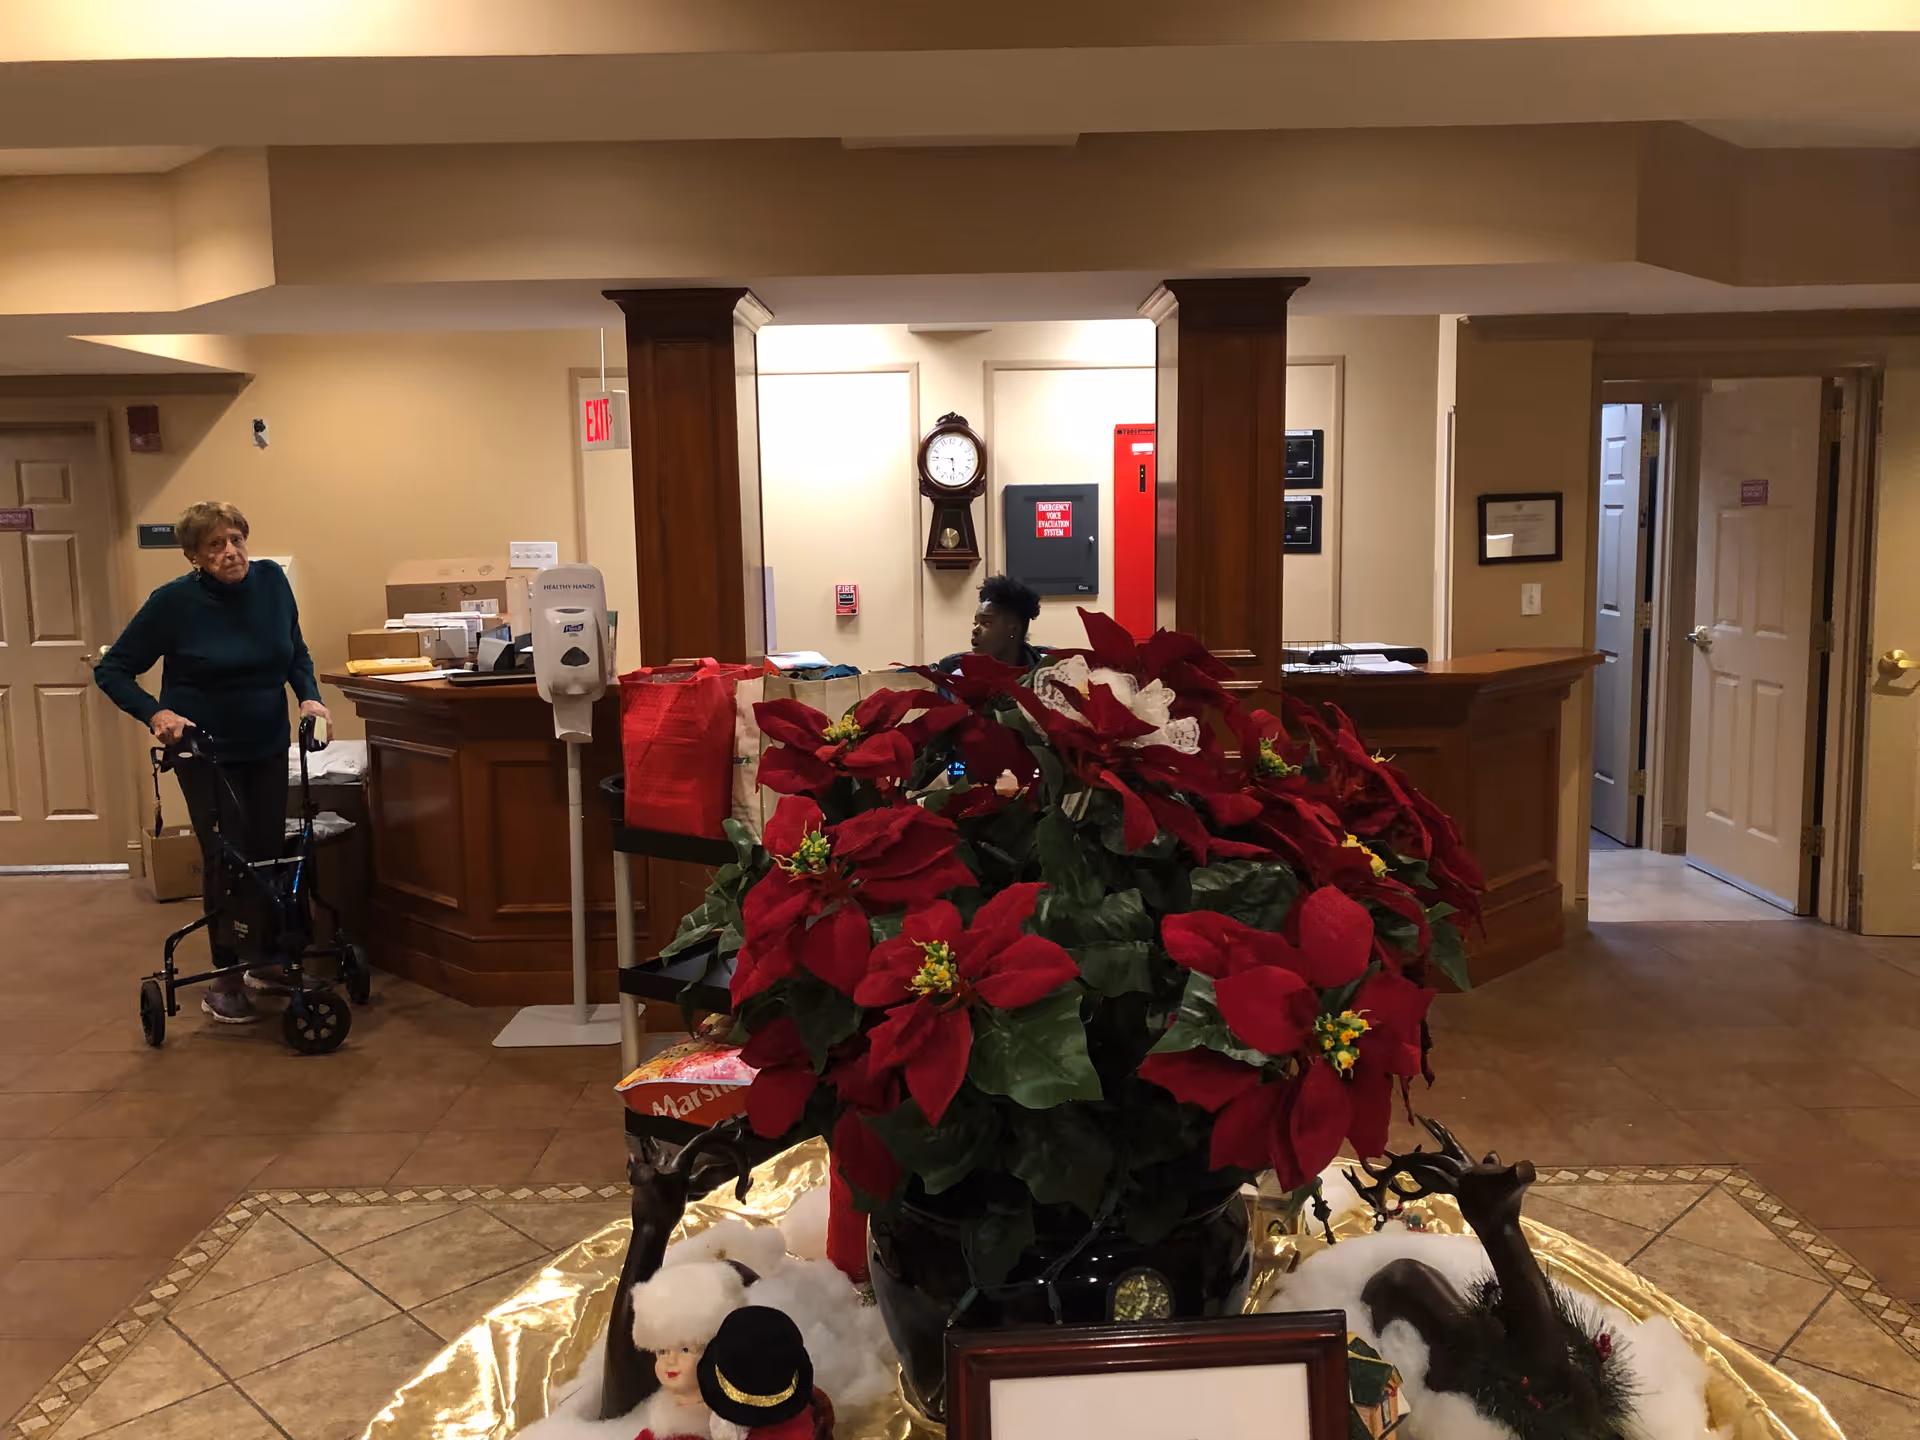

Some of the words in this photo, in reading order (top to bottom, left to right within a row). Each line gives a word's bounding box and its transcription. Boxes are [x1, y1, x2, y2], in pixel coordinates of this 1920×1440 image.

[585, 398, 610, 442] EXIT
[1038, 503, 1070, 511] EMERGENCY
[1046, 512, 1062, 520] VOICE
[1038, 520, 1070, 528] EVACUATION
[1043, 528, 1064, 536] SYSTEM
[837, 585, 855, 593] FIRE
